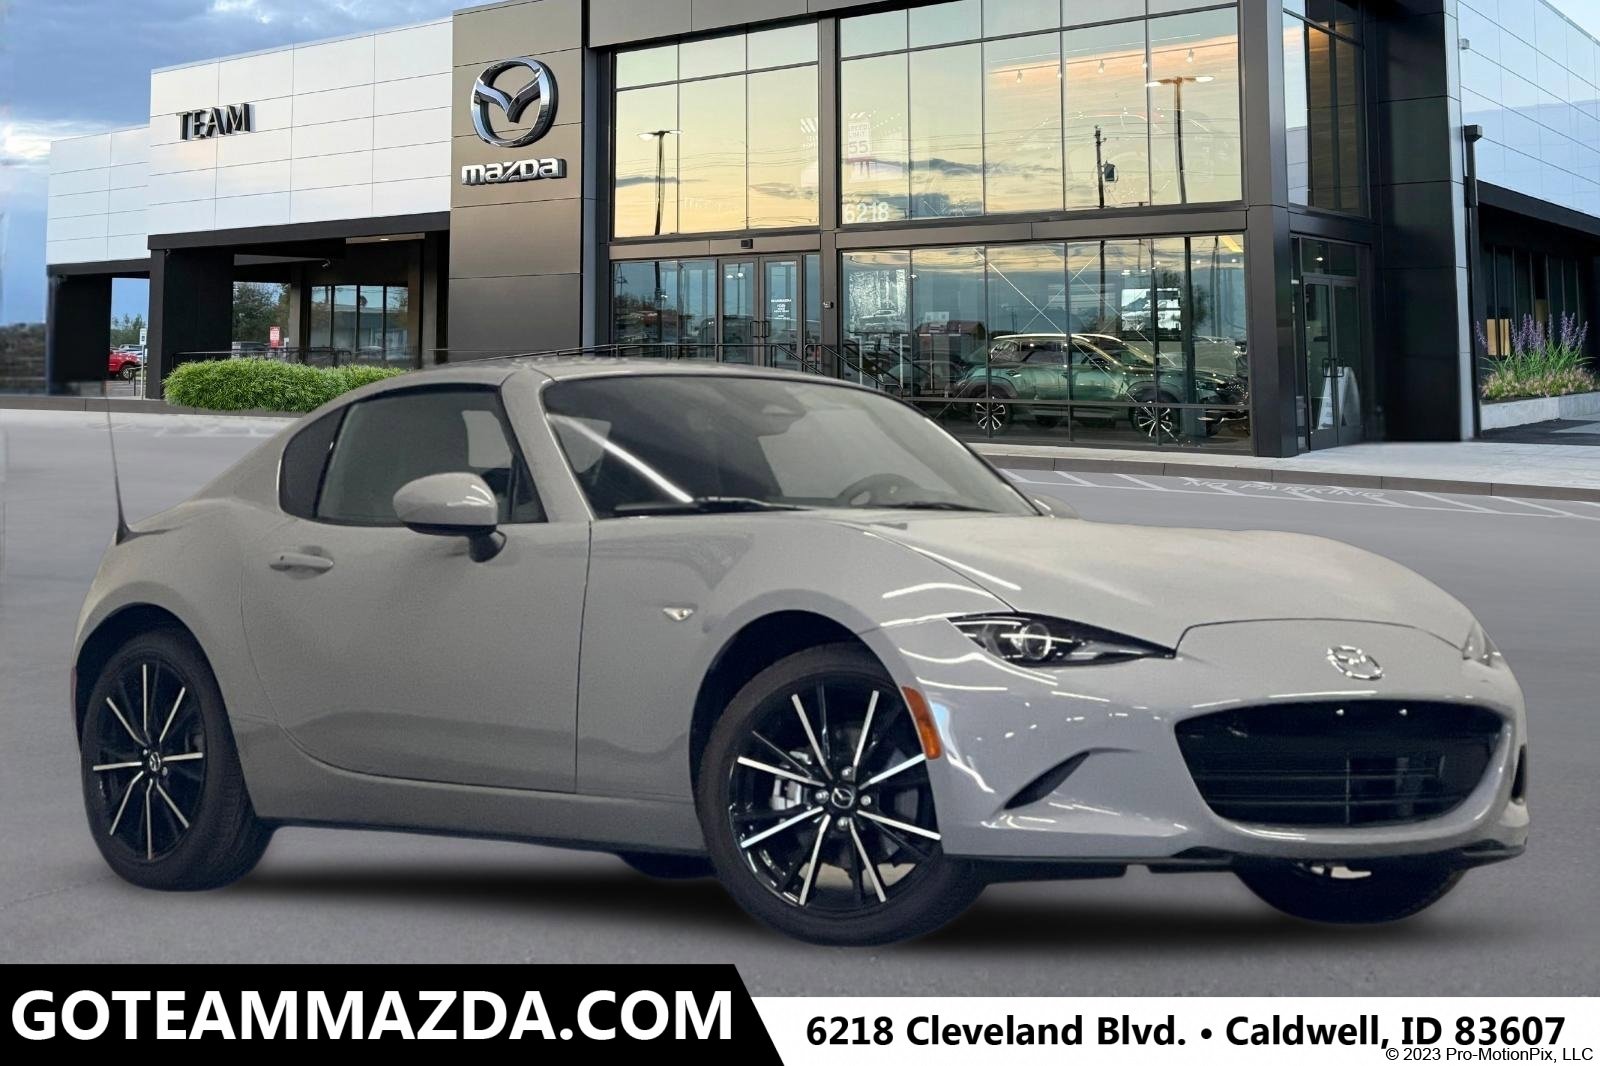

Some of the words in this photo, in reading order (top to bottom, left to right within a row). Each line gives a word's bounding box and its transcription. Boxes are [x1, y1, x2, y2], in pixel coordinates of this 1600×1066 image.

[177, 103, 256, 140] TEAM
[461, 157, 567, 186] mazda
[844, 202, 890, 223] 6218
[1184, 479, 1230, 489] NO
[1240, 483, 1386, 498] PARKING
